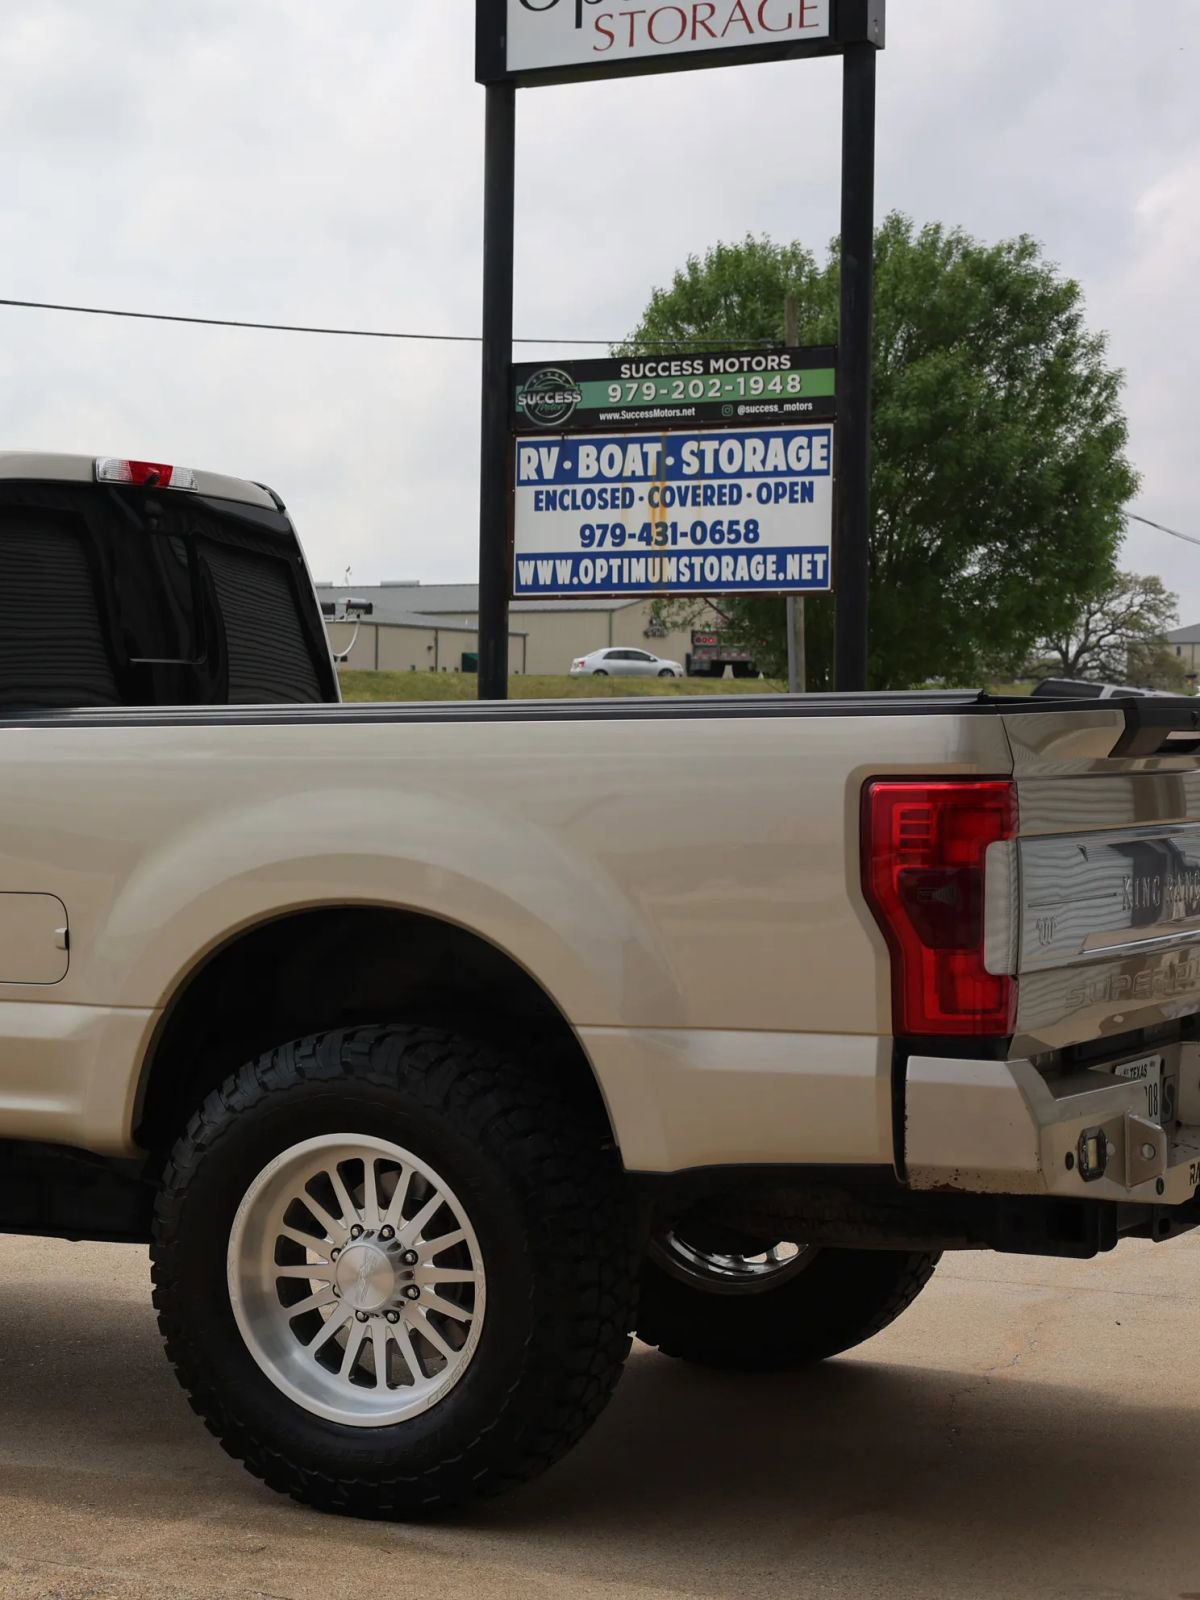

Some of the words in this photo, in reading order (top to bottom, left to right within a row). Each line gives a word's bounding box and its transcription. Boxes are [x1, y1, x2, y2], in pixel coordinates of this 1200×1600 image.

[593, 0, 819, 51] STORAGE
[620, 360, 703, 378] SUCCESS
[709, 355, 791, 373] MOTORS
[518, 390, 582, 405] SUCCESS
[608, 374, 801, 403] 979-202-1948
[599, 407, 696, 420] www.SuccessMotors.net
[737, 402, 813, 416] @success_motors
[519, 447, 559, 480] RV
[578, 443, 662, 478] BOAT
[681, 435, 829, 475] STORAGE
[534, 487, 634, 511] ENCLOSED
[648, 483, 743, 508] COVERED
[756, 481, 814, 505] OPEN
[579, 519, 760, 548] 979-431-0658
[518, 553, 827, 585] WWW.OPTIMUMSTORAGE.NET
[1122, 874, 1160, 911] KING
[1130, 1063, 1148, 1080] TEXAS
